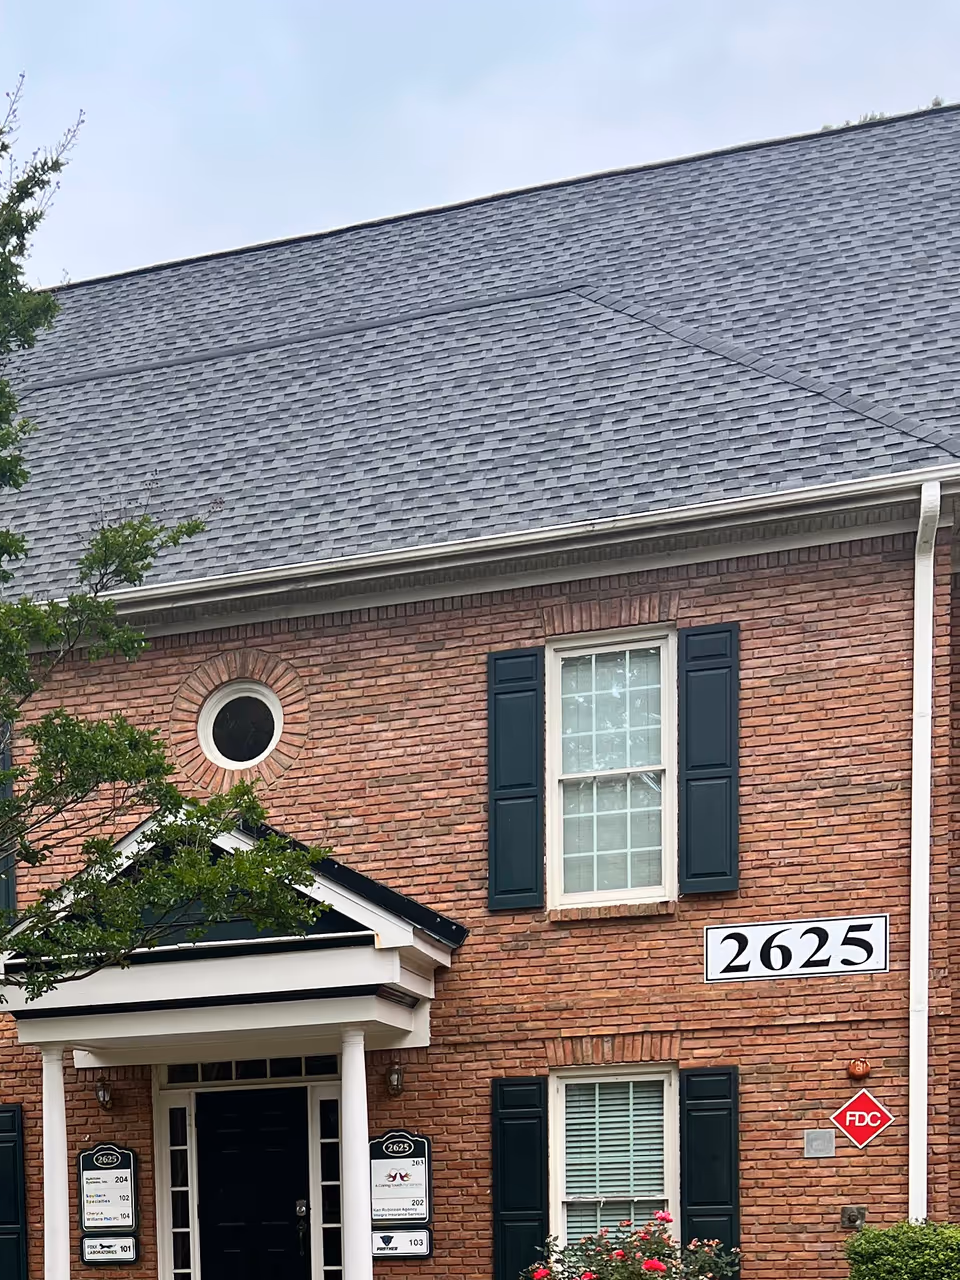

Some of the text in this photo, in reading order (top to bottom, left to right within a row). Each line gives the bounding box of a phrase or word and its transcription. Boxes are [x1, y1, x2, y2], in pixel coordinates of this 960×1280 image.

[720, 923, 874, 974] 2625
[845, 1111, 881, 1127] FDC
[387, 1143, 409, 1152] 2625
[97, 1155, 117, 1164] 2625
[114, 1176, 129, 1184] 204
[119, 1194, 130, 1202] 102
[411, 1199, 424, 1207] 202
[409, 1238, 424, 1247] 103
